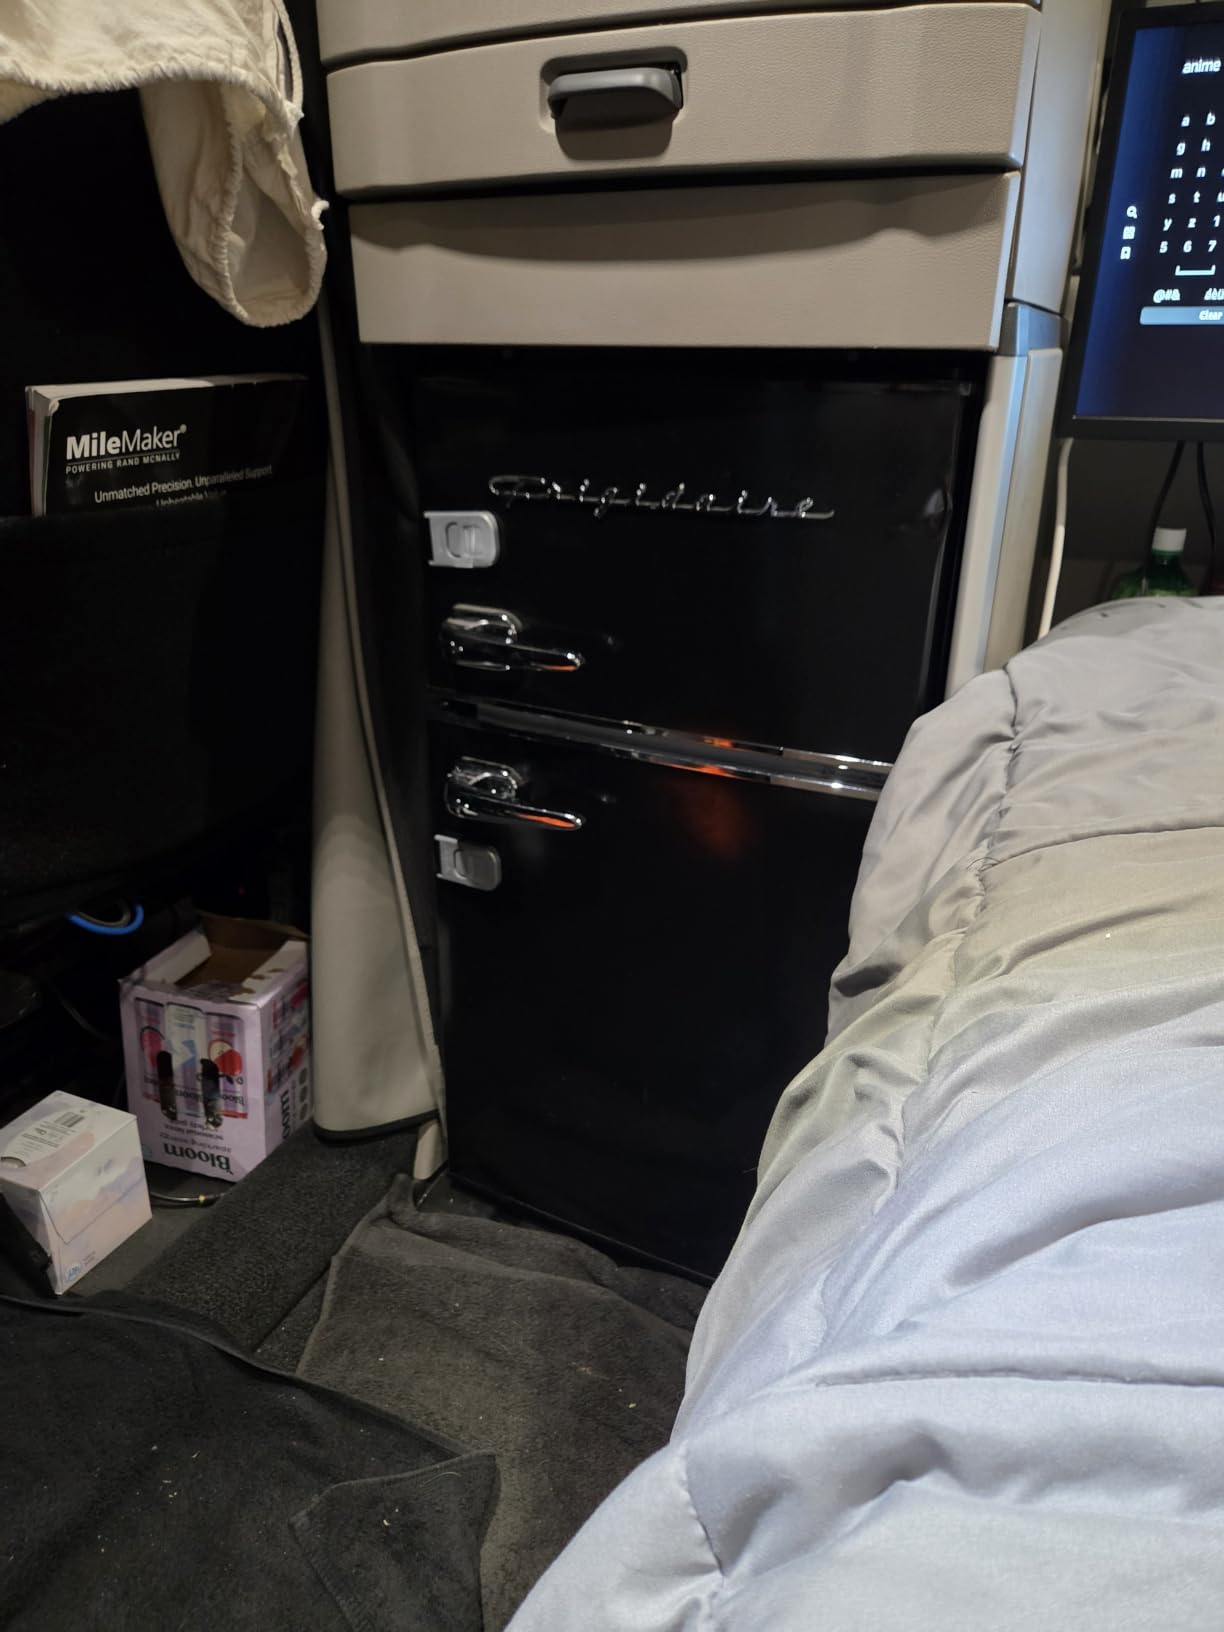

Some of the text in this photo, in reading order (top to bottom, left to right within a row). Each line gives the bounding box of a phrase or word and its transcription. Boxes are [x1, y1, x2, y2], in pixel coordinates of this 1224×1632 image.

[1182, 58, 1222, 74] anime
[1181, 112, 1216, 127] a b
[1176, 139, 1211, 155] g h
[1170, 166, 1206, 179] m n
[1168, 193, 1176, 204] s
[1193, 191, 1200, 203] t
[1163, 215, 1220, 231] y z 1
[1159, 240, 1217, 253] 5 6 7
[66, 452, 181, 474] POWERING RAND MCNALLY
[94, 482, 150, 503] Unmatched
[163, 1143, 232, 1174] Bloom
